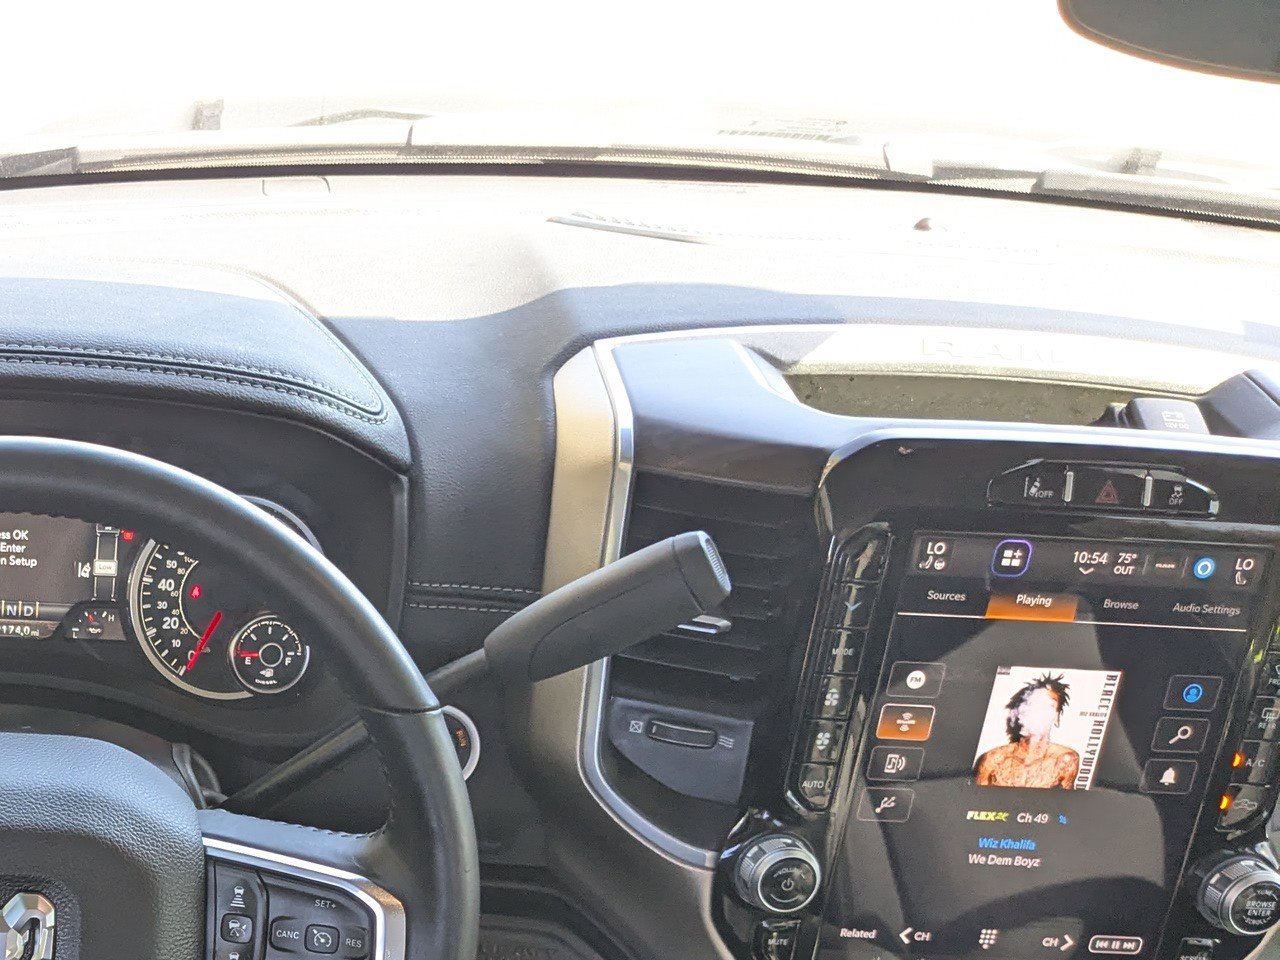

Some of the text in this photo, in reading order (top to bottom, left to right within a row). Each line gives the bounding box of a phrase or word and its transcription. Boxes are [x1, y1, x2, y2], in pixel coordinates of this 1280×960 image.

[1038, 489, 1053, 499] OFF
[1169, 498, 1183, 506] OFF
[12, 530, 29, 541] OK
[0, 543, 26, 553] Enter
[926, 542, 947, 555] LO
[9, 555, 38, 568] Setup
[1073, 551, 1108, 565] 10:54
[98, 563, 113, 571] Low
[166, 560, 177, 569] 50
[1114, 565, 1135, 575] OUT
[1235, 558, 1255, 571] LO
[177, 567, 186, 575] 80
[157, 579, 175, 591] 40
[927, 590, 966, 602] Sources
[1016, 594, 1052, 608] Playing
[157, 601, 168, 610] 30
[1104, 599, 1139, 610] Browse
[1173, 603, 1241, 617] Audio Settings
[6, 604, 18, 616] N
[23, 605, 34, 617] D
[108, 614, 115, 622] H
[162, 617, 179, 629] 20
[72, 631, 78, 639] L
[180, 627, 188, 635] 20
[172, 639, 181, 648] 10
[245, 657, 252, 665] E
[285, 657, 292, 666] F
[1245, 758, 1266, 767] A/C
[801, 781, 824, 789] AUTO
[1016, 812, 1032, 823] Ch
[1033, 813, 1049, 824] 49
[978, 838, 1037, 850] Wiz Khalifa
[968, 854, 1042, 868] We Dem Boyz
[1246, 900, 1277, 908] BROWSE
[1247, 908, 1271, 917] ENTER
[276, 929, 300, 940] CANC
[840, 928, 877, 939] Related
[914, 931, 932, 942] CH
[345, 938, 362, 949] RES
[767, 938, 788, 946] MUTE
[1042, 937, 1059, 948] CH
